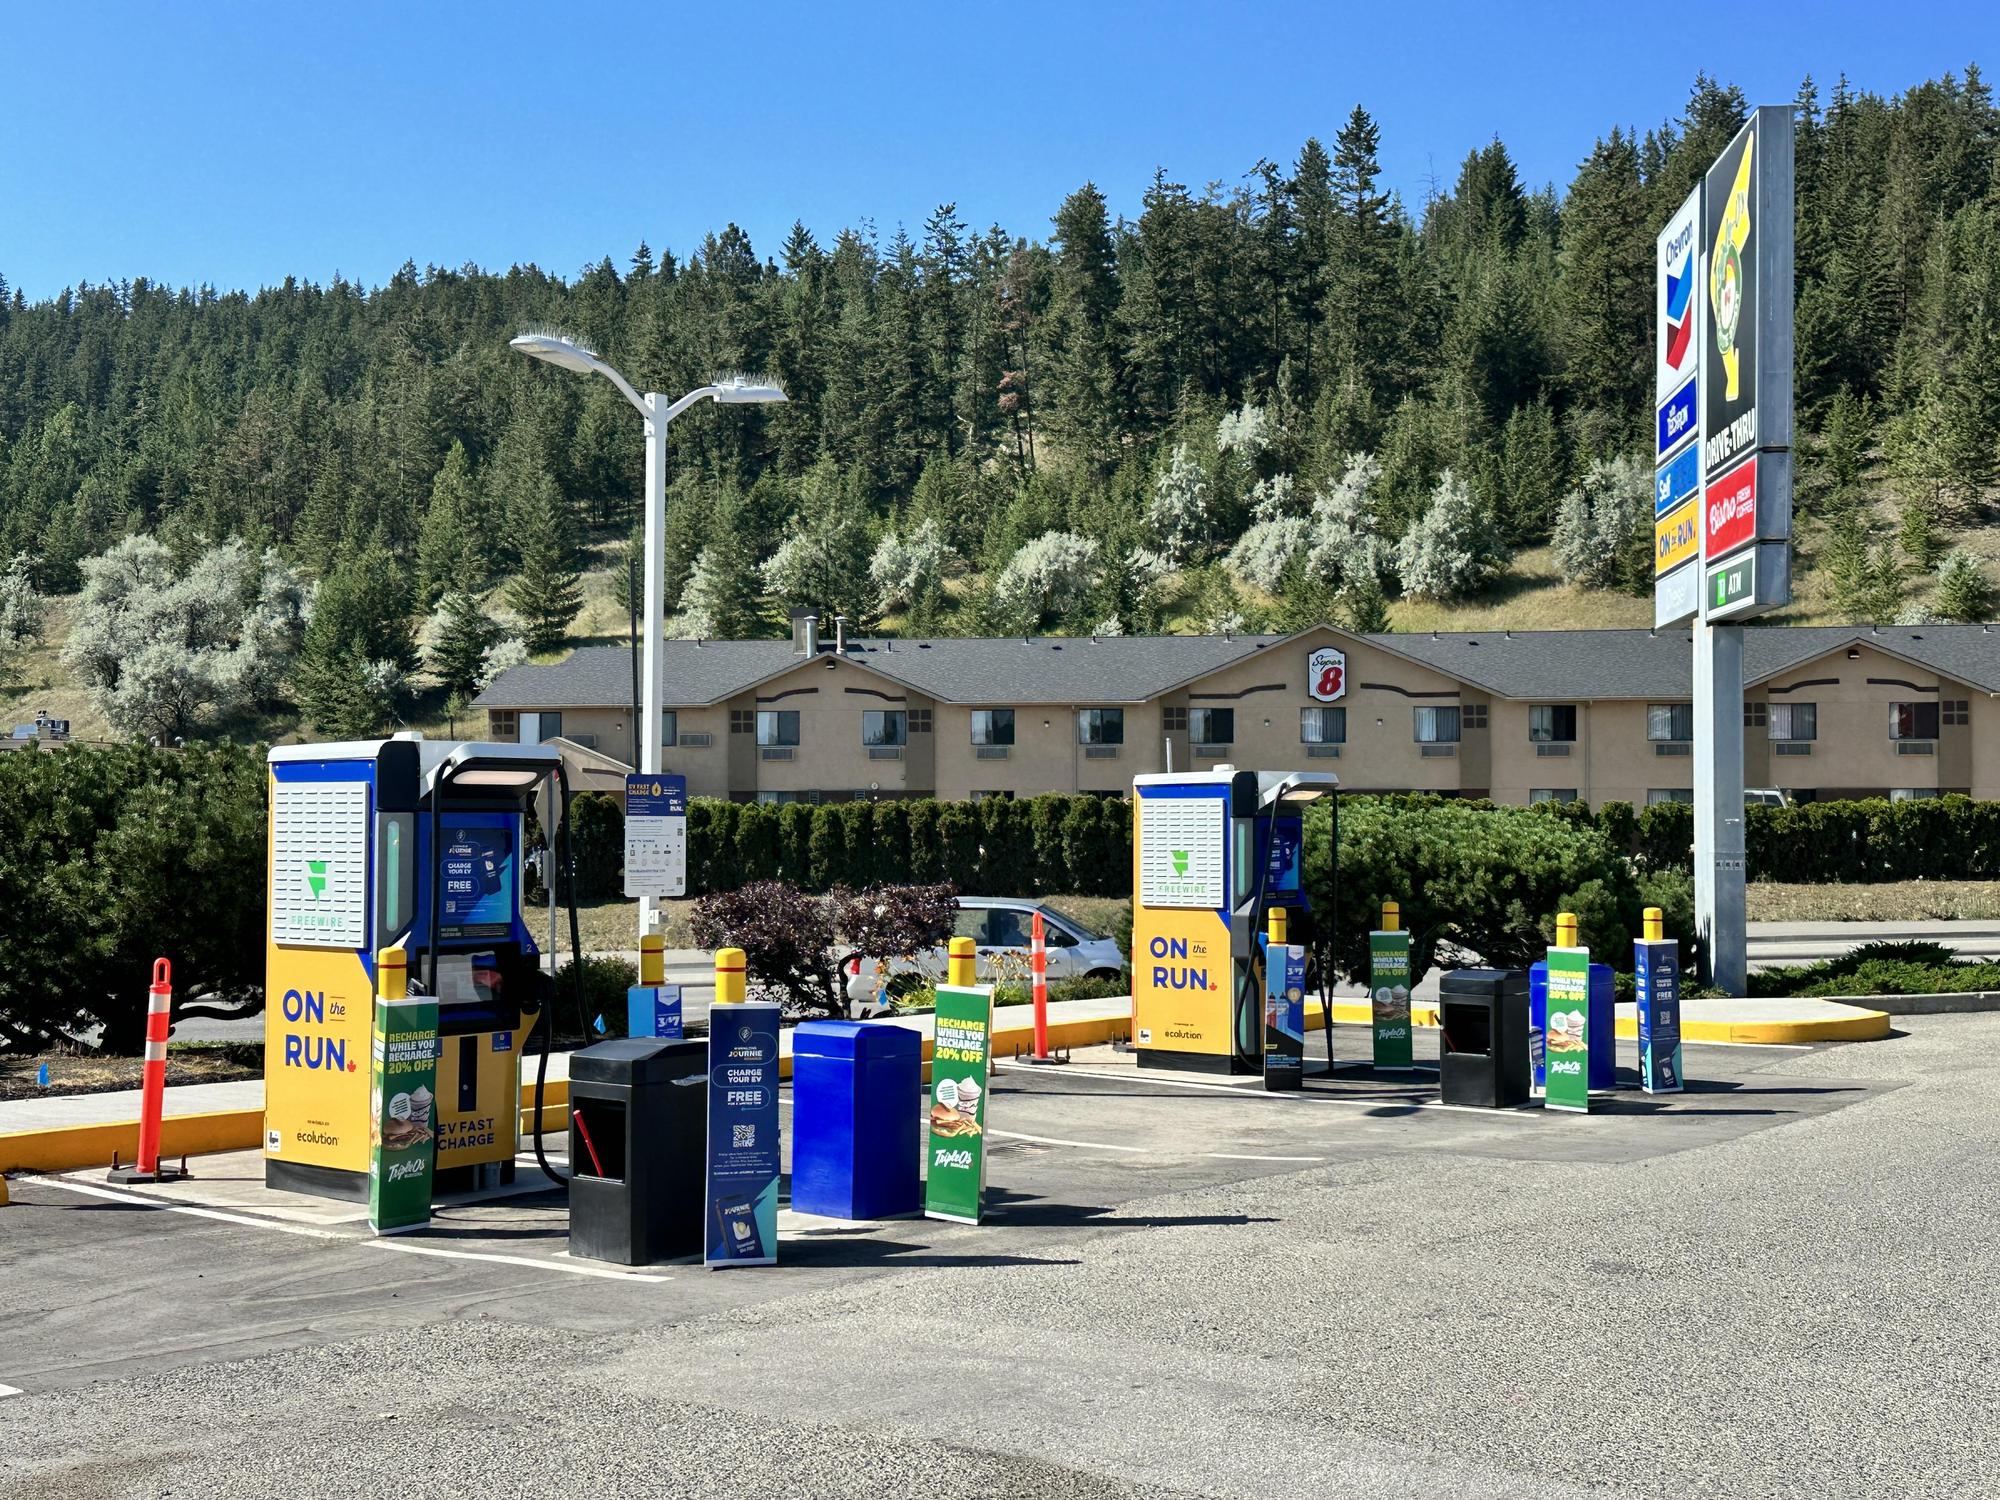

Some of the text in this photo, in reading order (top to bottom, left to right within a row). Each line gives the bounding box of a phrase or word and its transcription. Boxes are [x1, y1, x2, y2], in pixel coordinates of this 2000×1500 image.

[1666, 220, 1692, 268] Chevron
[1659, 473, 1671, 502] Self
[1710, 496, 1736, 535] Bistro
[1660, 531, 1670, 558] ON
[1728, 571, 1741, 595] ATM
[1312, 655, 1342, 672] Super
[1316, 667, 1343, 696] 8
[448, 881, 472, 890] FREE
[291, 916, 343, 927] FREEWIRE
[526, 944, 532, 953] 2
[1150, 937, 1207, 959] ON the
[283, 989, 346, 1024] ON the
[937, 1017, 985, 1031] RECHARGE
[389, 1030, 436, 1042] RECHARGE
[937, 1027, 984, 1041] WHILE YOU
[390, 1040, 435, 1052] WHILE YOU
[937, 1036, 984, 1051] RECHARGE.
[389, 1050, 434, 1062] RECHARGE.
[936, 1047, 982, 1063] 20% OFF
[389, 1059, 434, 1074] 20% OFF
[728, 1091, 762, 1102] FREE
[438, 1118, 494, 1135] EV FAST
[438, 1133, 494, 1150] CHARGE
